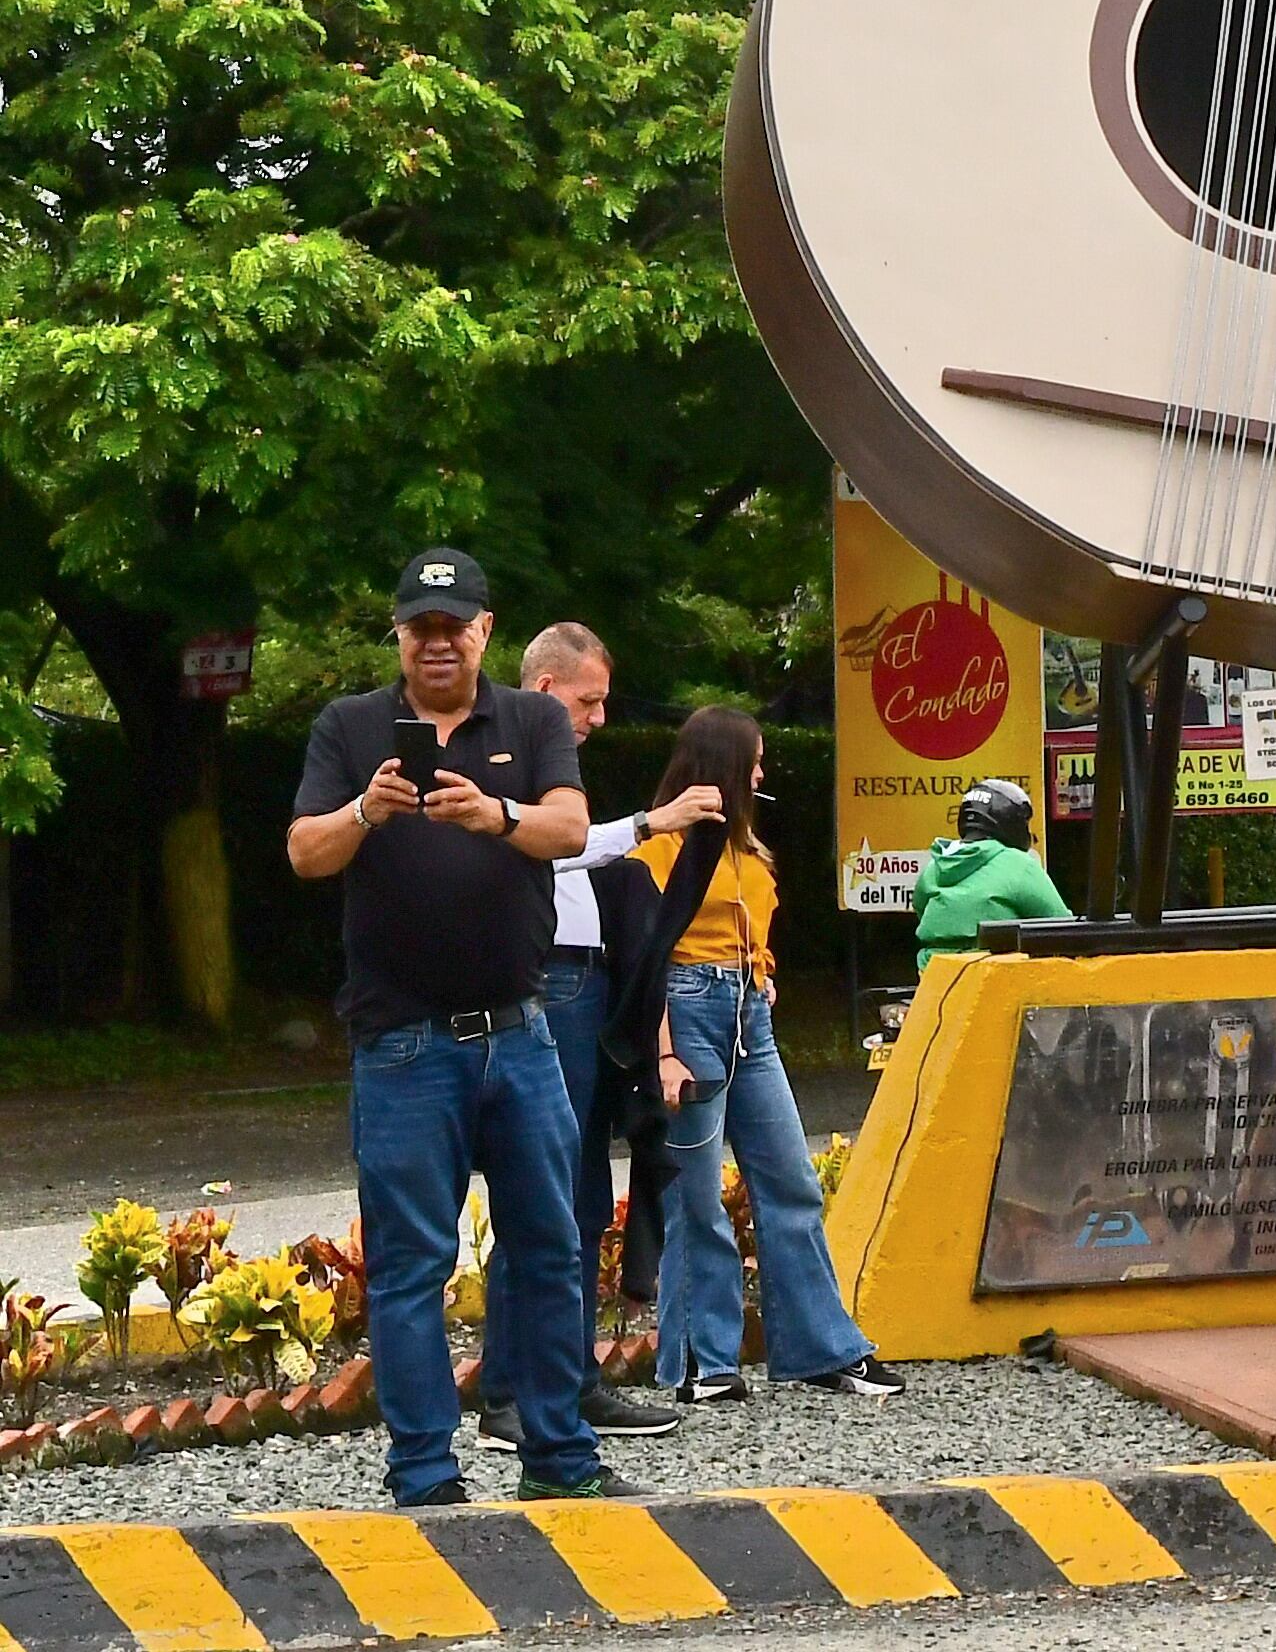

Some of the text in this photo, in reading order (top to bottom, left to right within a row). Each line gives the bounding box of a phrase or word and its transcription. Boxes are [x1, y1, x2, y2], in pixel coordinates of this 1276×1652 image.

[881, 606, 936, 669] El
[884, 655, 1006, 724] Condado
[1247, 700, 1264, 708] LOS
[1199, 755, 1223, 773] DE
[853, 775, 1031, 797] RESTAURAE
[1187, 781, 1195, 789] 6
[1198, 780, 1214, 789] No
[1218, 780, 1243, 789] 1-25
[1186, 793, 1219, 805] 693
[1225, 792, 1269, 804] 6460
[856, 856, 919, 874] 30 Años
[860, 885, 914, 910] del Típ
[1105, 1159, 1179, 1177] ERGUIDA
[1183, 1155, 1226, 1172] PARA
[1231, 1154, 1252, 1169] LA
[1168, 1201, 1232, 1218] CAMILO
[1235, 1198, 1276, 1215] JOSE
